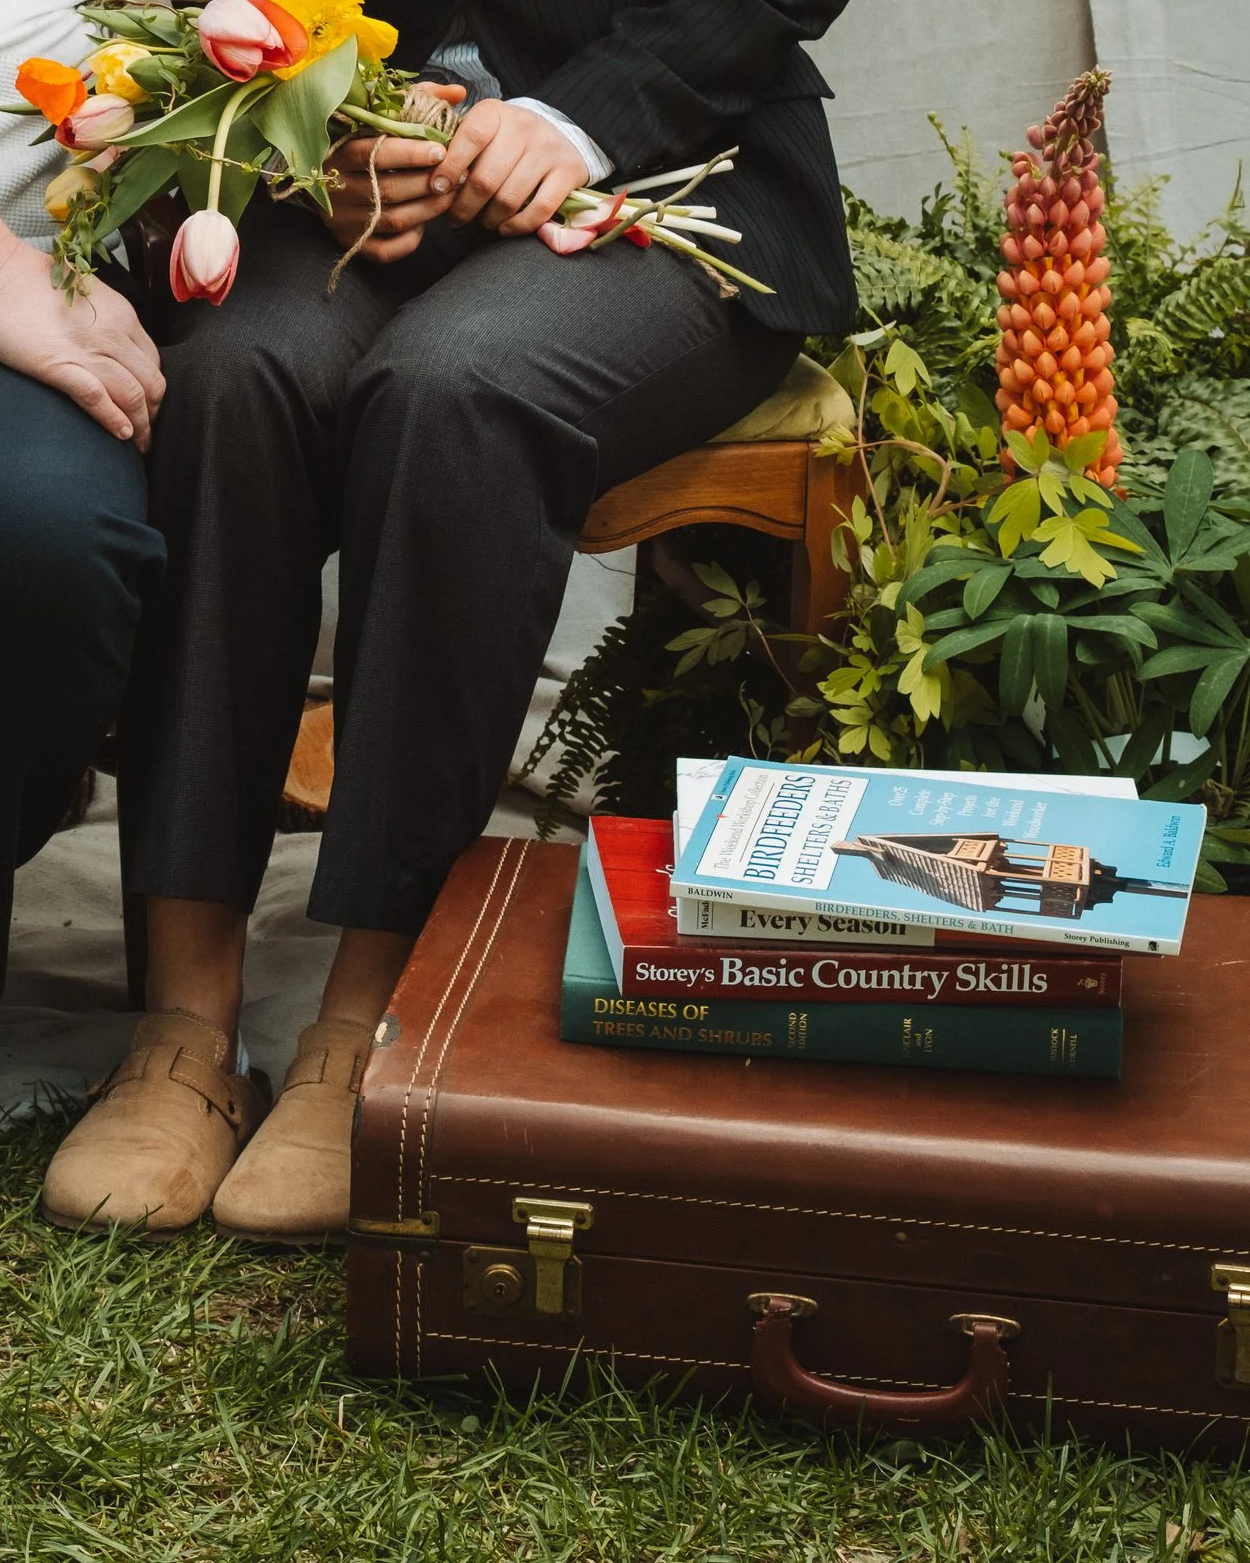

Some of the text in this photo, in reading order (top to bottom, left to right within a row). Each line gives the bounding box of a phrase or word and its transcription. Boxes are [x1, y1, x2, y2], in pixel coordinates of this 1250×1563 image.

[743, 774, 816, 881] BIRDFEEDERS
[791, 822, 833, 884] SHELTERS
[819, 779, 852, 814] BATHS
[1163, 815, 1181, 839] Baldwin
[1156, 845, 1173, 868] Edward
[687, 887, 733, 900] BALDWIN
[740, 908, 813, 940] Every
[815, 902, 1014, 935] BIRDFEEDERS, SHELTERS & BATH
[1064, 932, 1130, 948] Storey Publishing
[636, 958, 1048, 999] Storey's Basic Country Skills
[594, 998, 710, 1021] DISEASES OF
[593, 1020, 773, 1047] TREES AND SHRUBS
